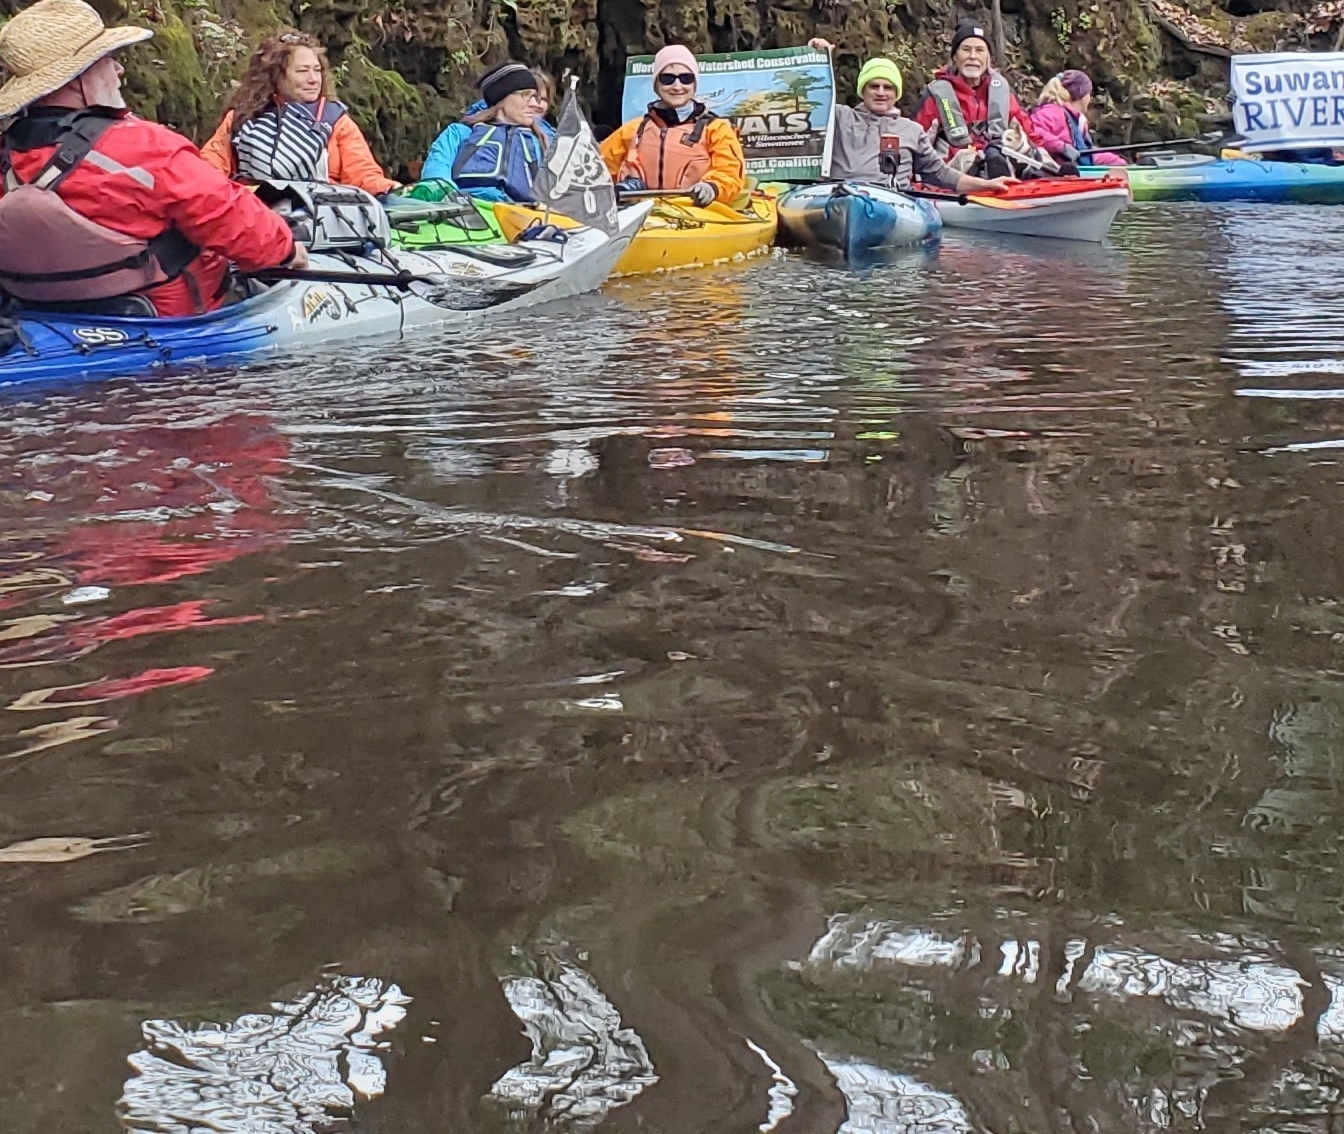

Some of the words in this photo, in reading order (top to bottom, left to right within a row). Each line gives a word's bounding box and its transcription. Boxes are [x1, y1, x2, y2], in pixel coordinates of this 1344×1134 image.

[698, 58, 755, 72] Watershed
[757, 53, 828, 69] Conservation
[755, 139, 805, 148] Suwannee
[77, 327, 124, 344] SS
